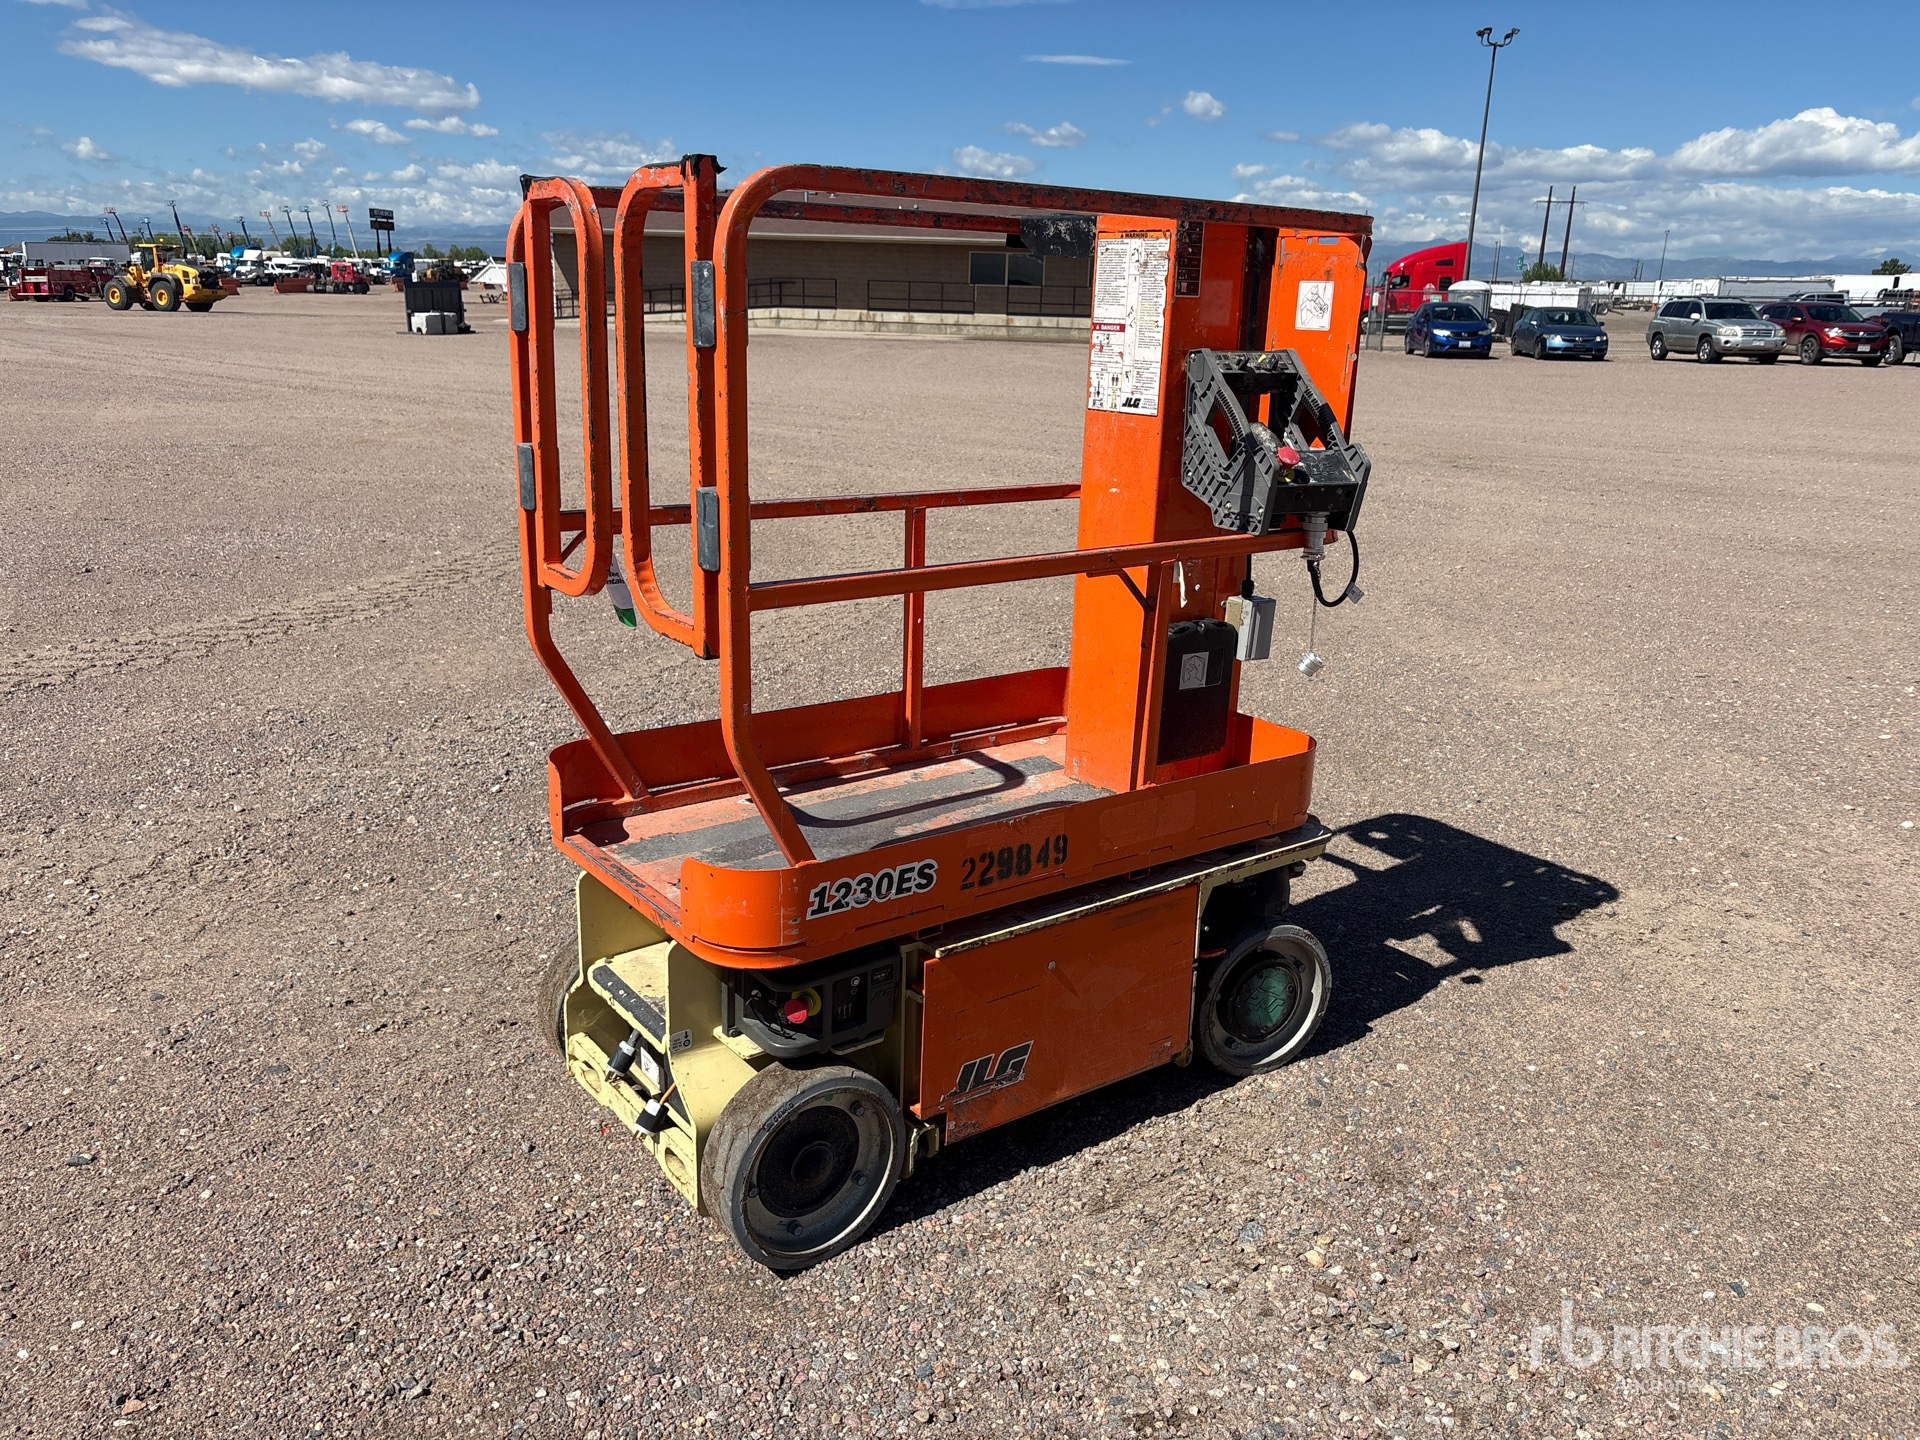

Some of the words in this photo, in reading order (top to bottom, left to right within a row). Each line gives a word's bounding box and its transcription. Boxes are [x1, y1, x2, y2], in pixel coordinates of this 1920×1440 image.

[1122, 397, 1141, 408] JLG
[806, 859, 938, 920] 1230ES
[960, 834, 1069, 891] 229849
[939, 1040, 1034, 1106] JLG
